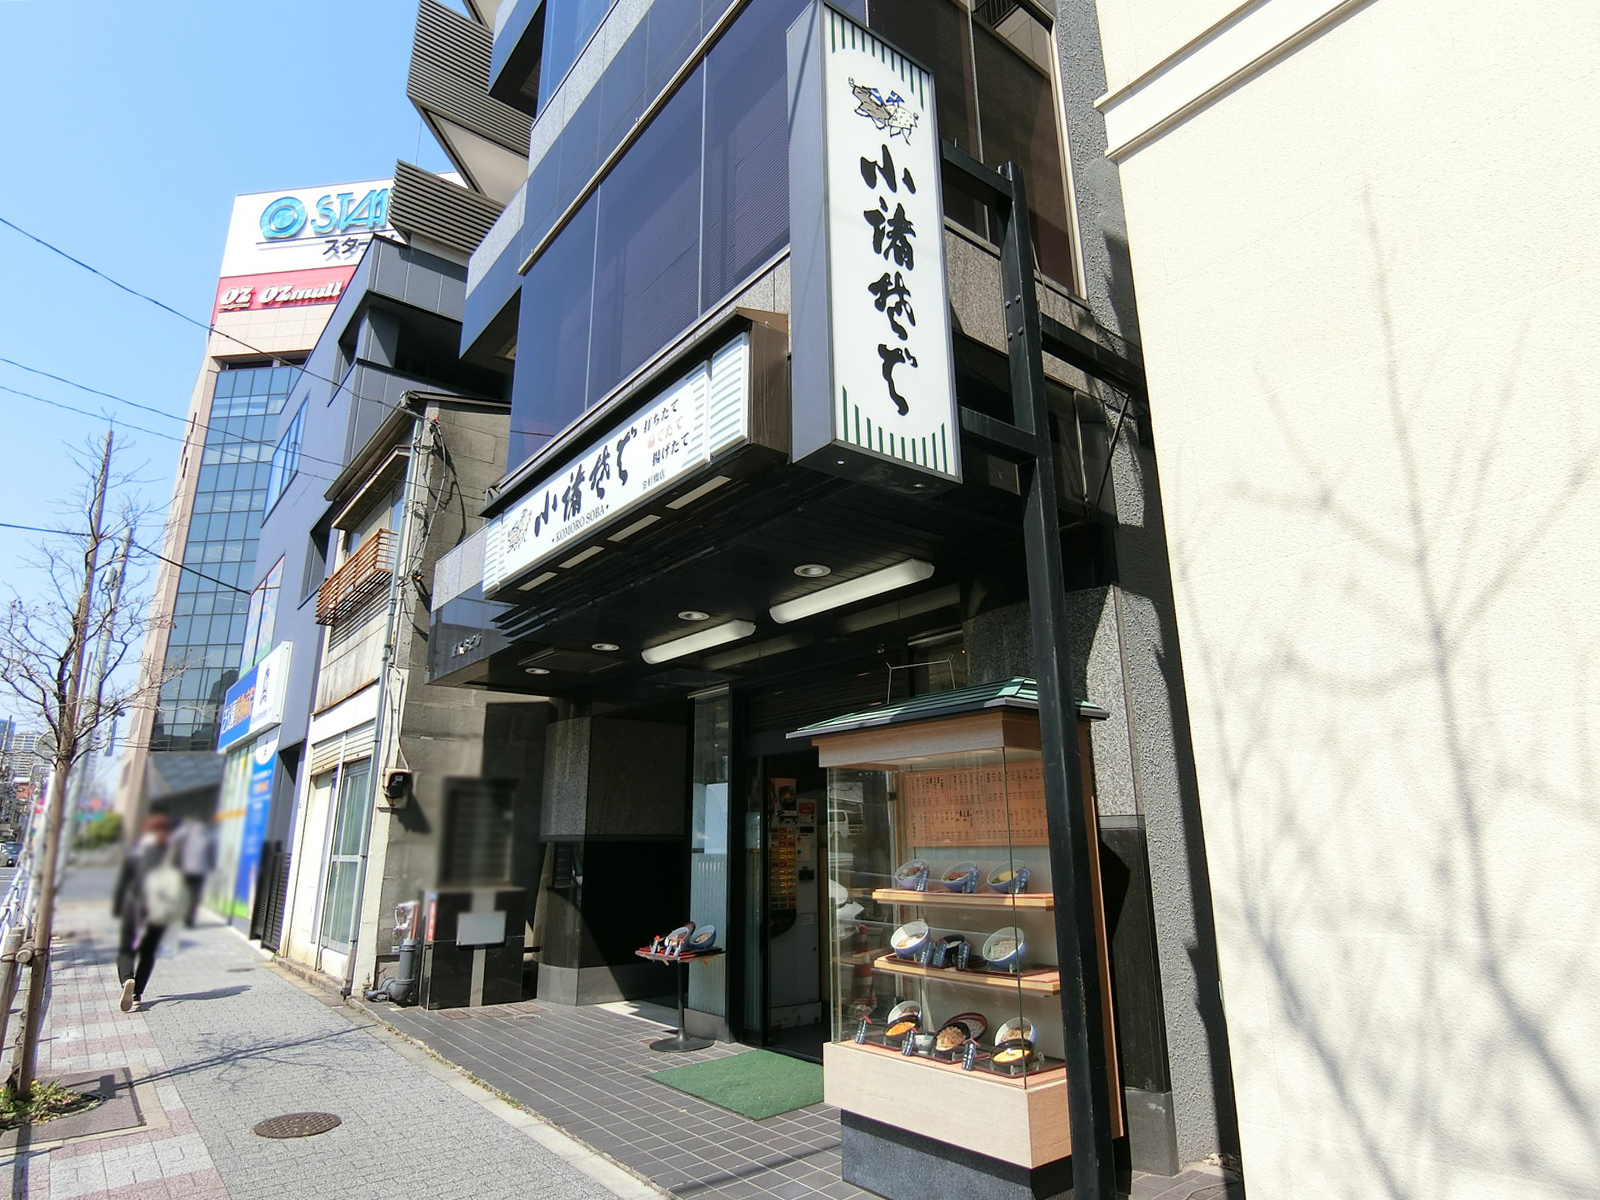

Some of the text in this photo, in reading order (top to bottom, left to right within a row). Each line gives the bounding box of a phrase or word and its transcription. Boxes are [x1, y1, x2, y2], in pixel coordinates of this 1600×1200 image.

[220, 281, 343, 305] OZ OZmall
[643, 398, 679, 434] 打ちたて
[652, 432, 689, 467] 揚げたて
[556, 505, 606, 542] KOMORO SOBA
